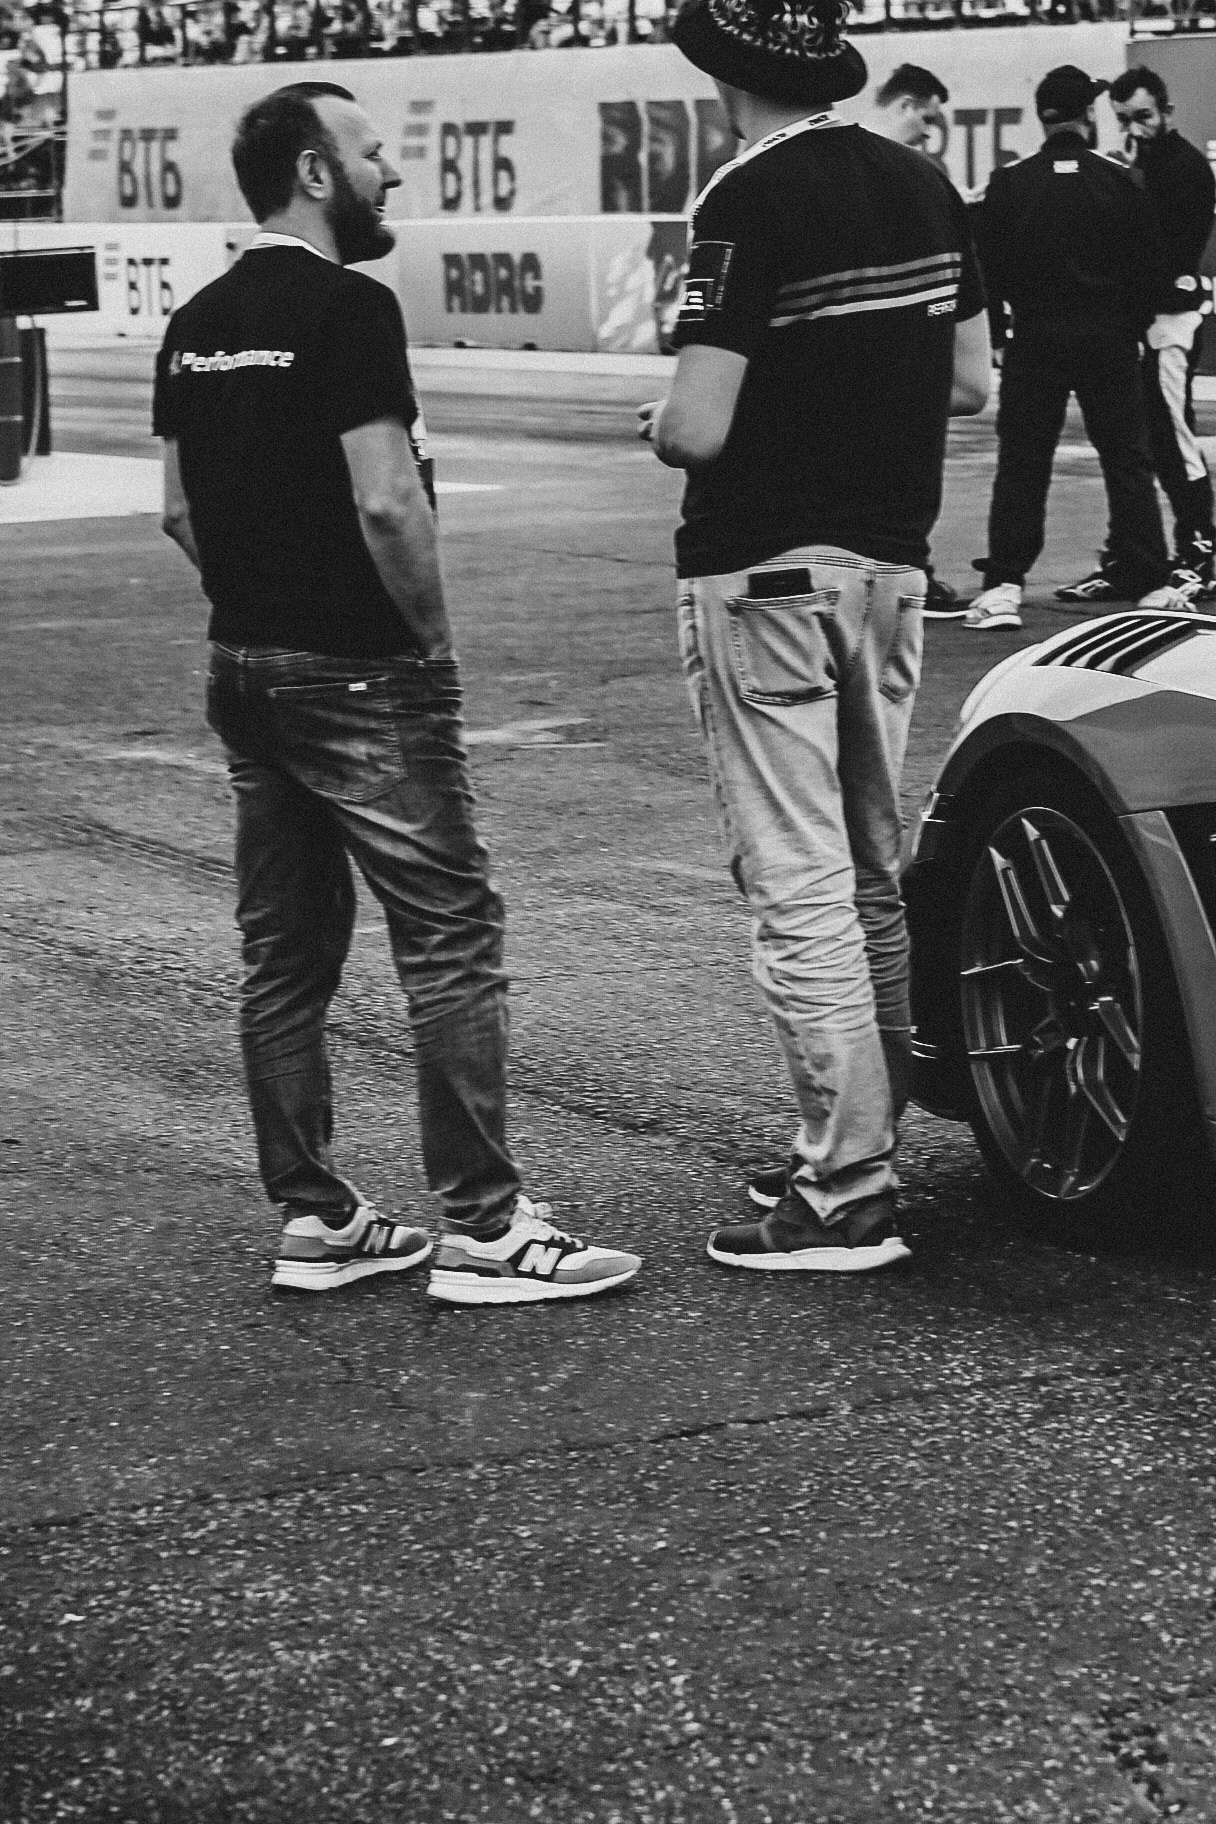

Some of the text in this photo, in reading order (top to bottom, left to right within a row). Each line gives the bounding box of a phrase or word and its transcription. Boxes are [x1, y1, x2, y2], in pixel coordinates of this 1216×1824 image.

[118, 128, 182, 209] ВТБ
[440, 120, 516, 212] ВТБ
[127, 258, 174, 315] ВТБ
[442, 252, 544, 314] RDRC
